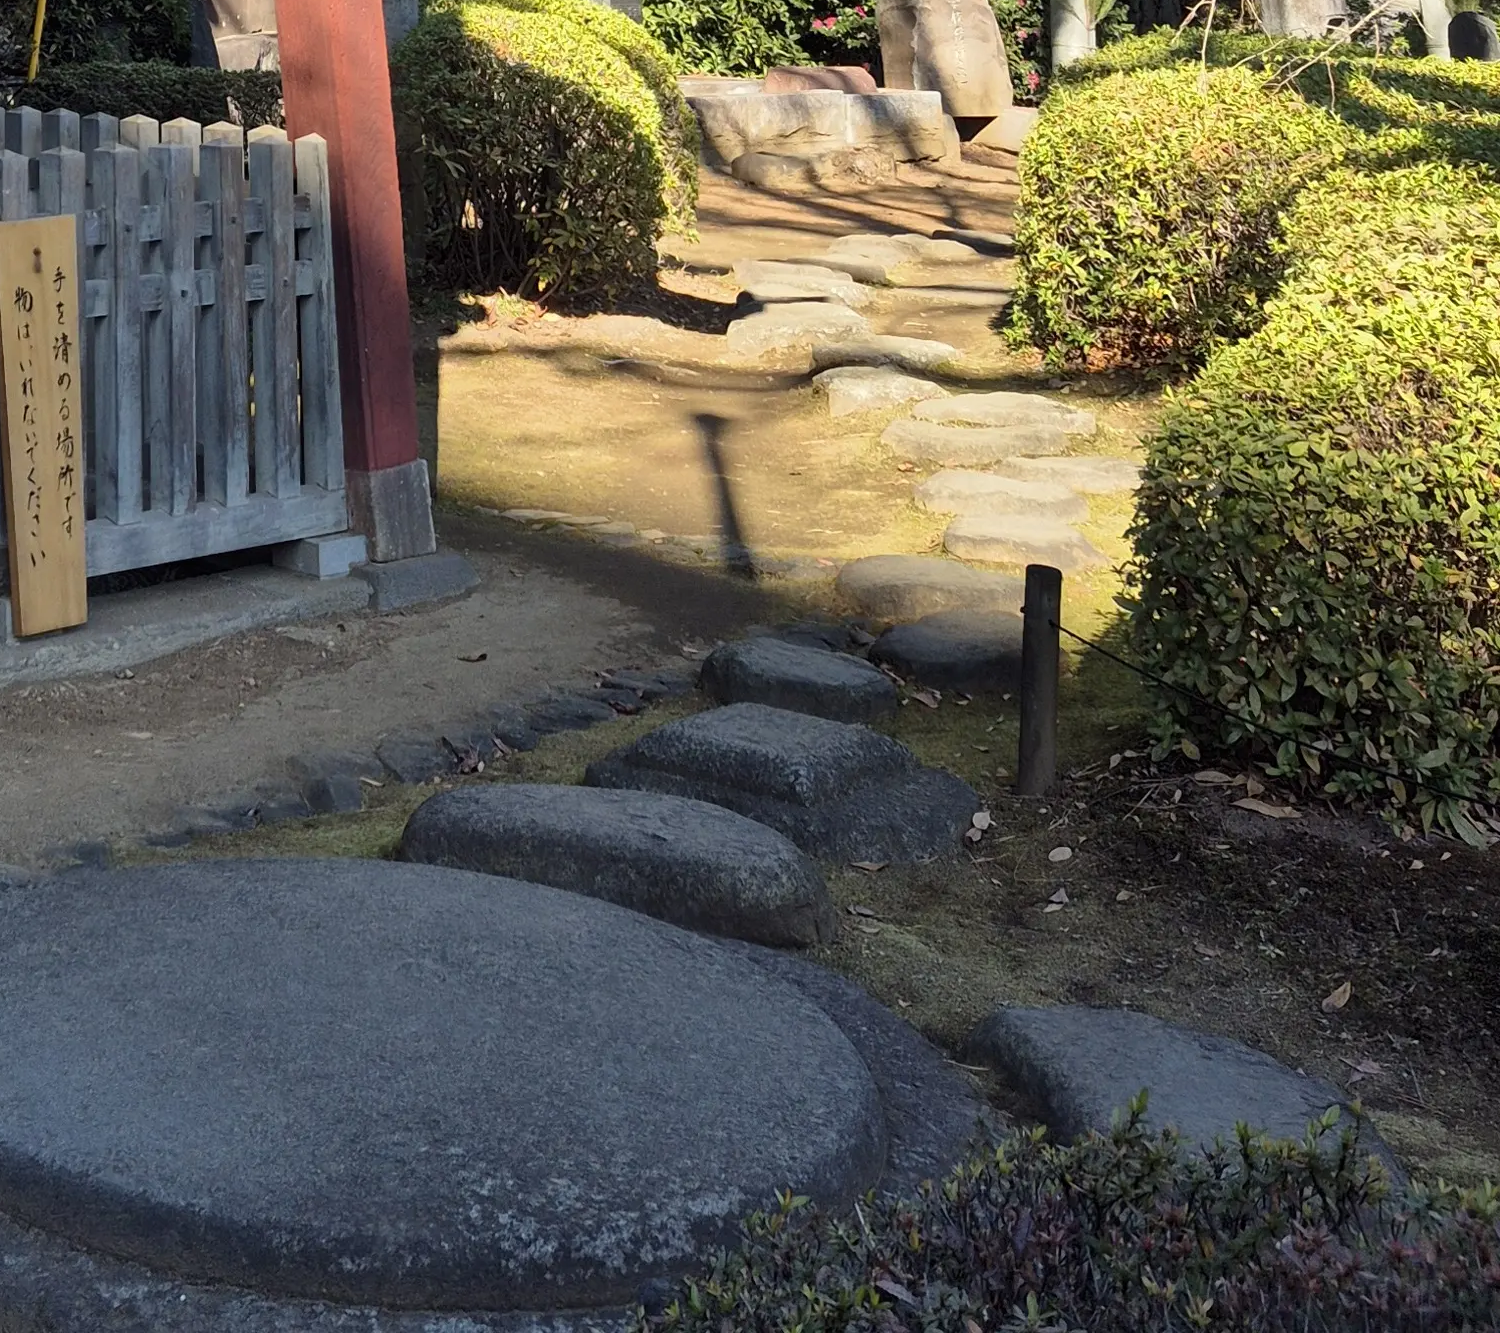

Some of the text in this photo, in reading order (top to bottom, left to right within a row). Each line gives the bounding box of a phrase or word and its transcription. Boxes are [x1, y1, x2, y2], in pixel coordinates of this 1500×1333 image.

[52, 265, 77, 540] 手を清める場所です
